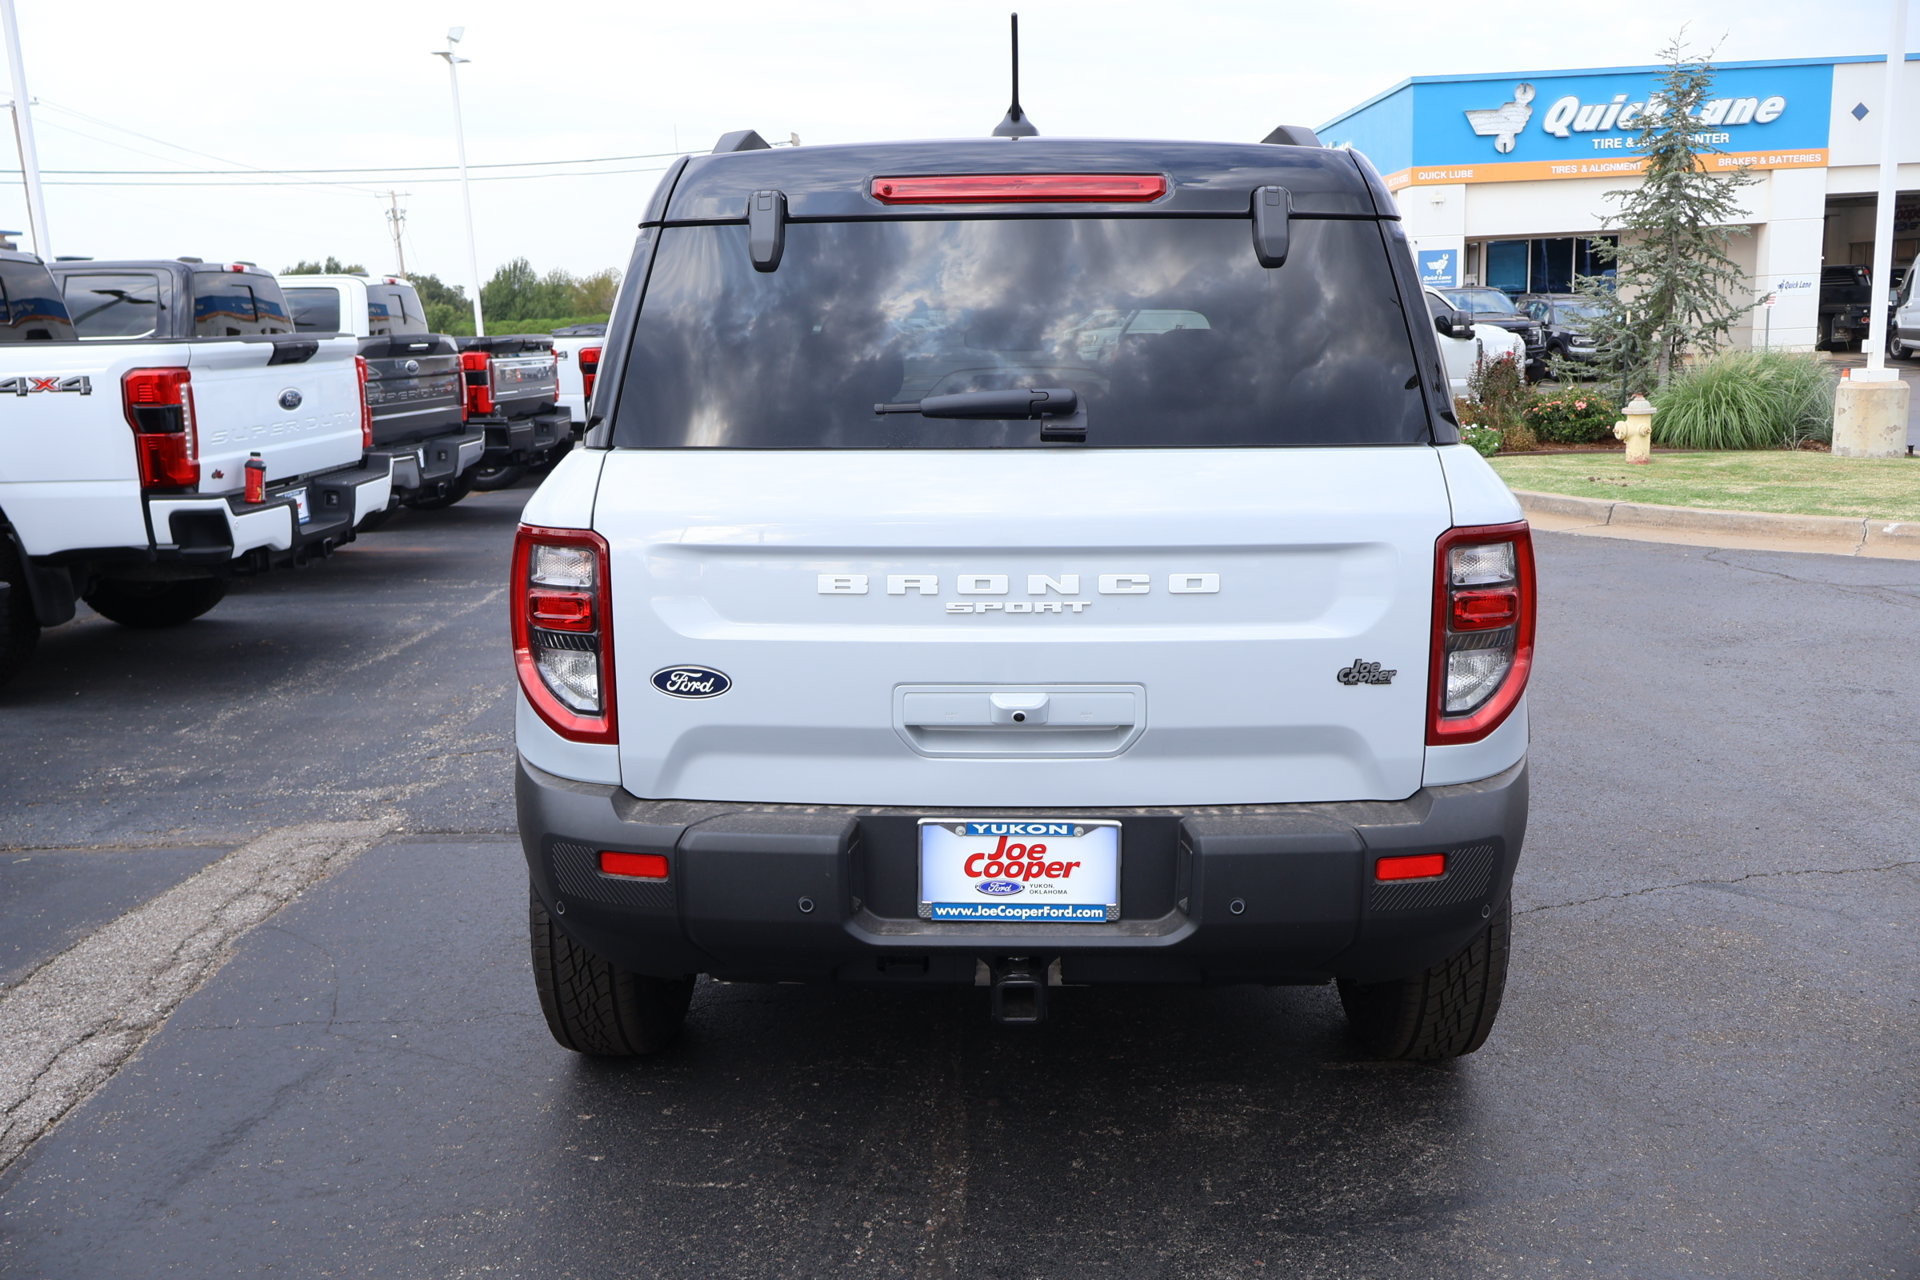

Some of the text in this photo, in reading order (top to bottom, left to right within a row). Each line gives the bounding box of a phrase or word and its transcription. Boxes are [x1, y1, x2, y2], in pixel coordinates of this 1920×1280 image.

[1542, 92, 1672, 138] Quick
[1592, 137, 1623, 149] TIRE
[1625, 137, 1635, 148] &
[1551, 161, 1642, 174] TIRES & ALIGNMENT
[1718, 153, 1822, 167] BRAKES & BATTERIES
[1418, 170, 1447, 180] QUICK
[1449, 169, 1474, 179] LUBE
[1785, 280, 1812, 290] Quick Lane
[211, 411, 356, 445] SUPER DUTY
[817, 573, 1221, 596] BRONCO
[945, 600, 1092, 614] SPORT
[1351, 658, 1381, 674] Joe
[1336, 667, 1397, 684] Cooper
[972, 824, 1068, 835] YUKON
[987, 835, 1046, 861] Joe
[964, 852, 1081, 882] Cooper
[935, 904, 1103, 920] www.JoeCooperFord.com
